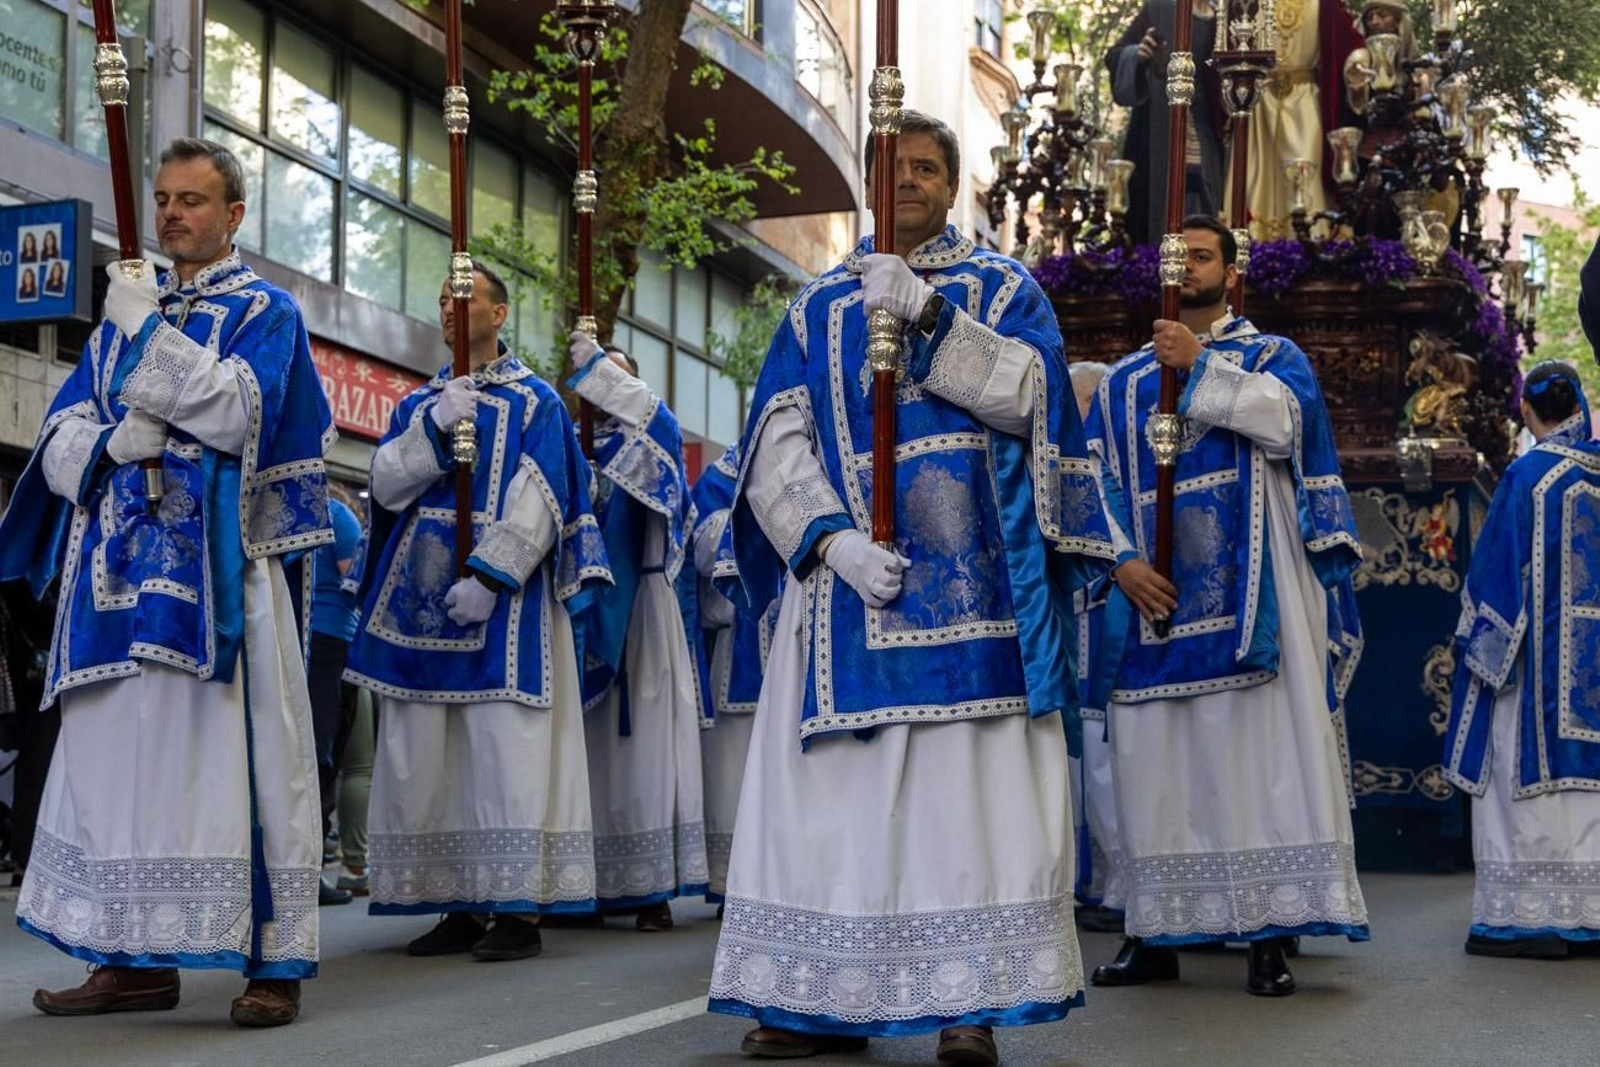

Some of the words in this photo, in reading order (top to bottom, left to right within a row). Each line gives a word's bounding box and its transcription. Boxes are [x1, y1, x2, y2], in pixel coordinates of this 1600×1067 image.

[0, 59, 26, 84] mo
[30, 71, 46, 92] tú
[320, 374, 394, 434] BAZAR
